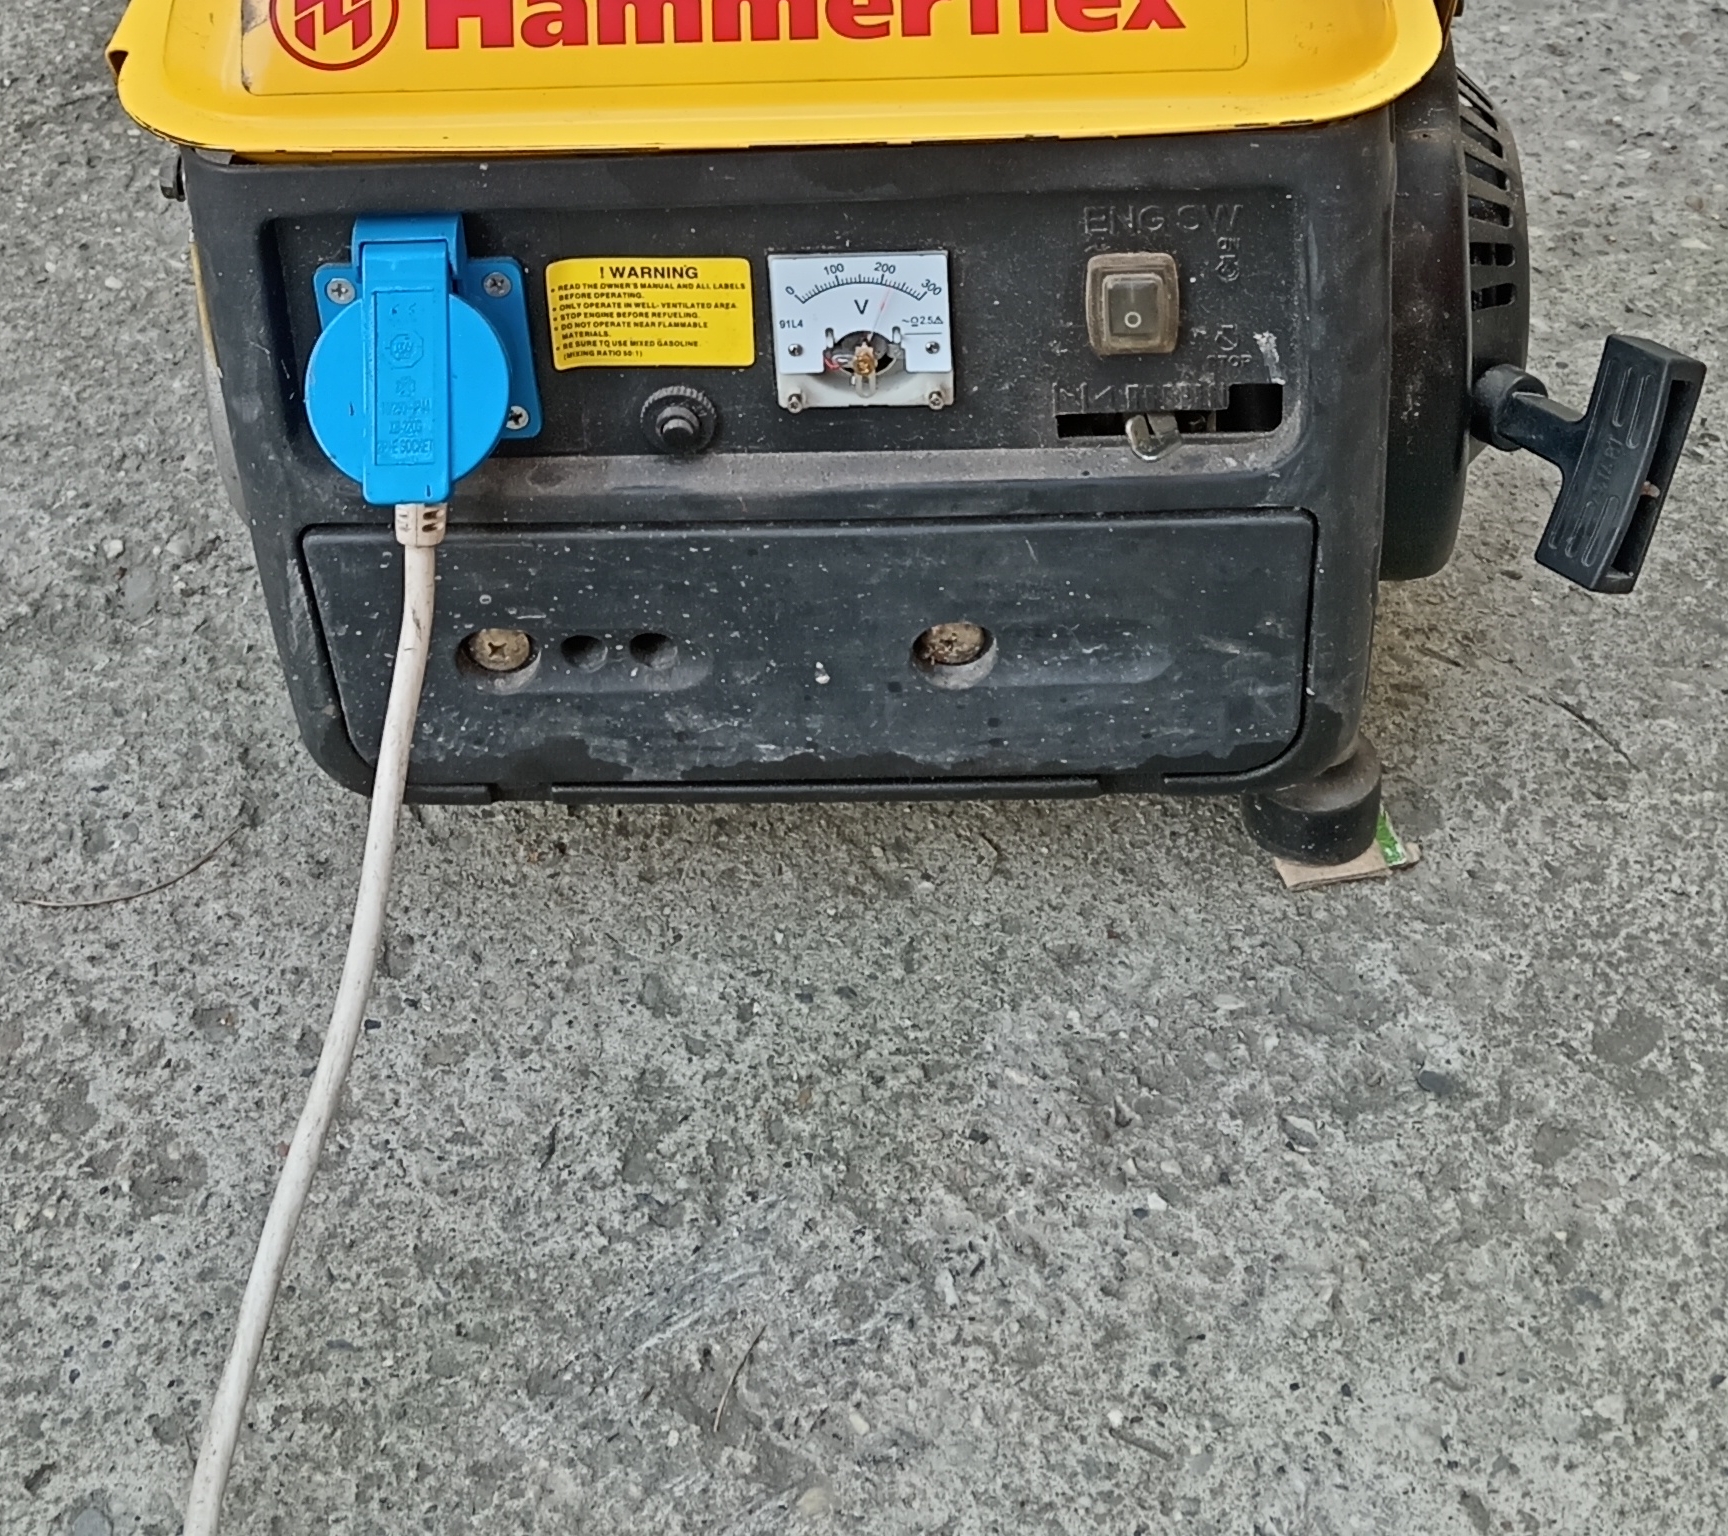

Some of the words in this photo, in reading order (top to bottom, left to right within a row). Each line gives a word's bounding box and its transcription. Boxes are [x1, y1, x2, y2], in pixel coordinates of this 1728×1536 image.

[1083, 204, 1165, 234] ENG
[609, 266, 699, 279] WARNING
[823, 263, 845, 276] 100
[874, 261, 896, 275] 200
[558, 283, 581, 292] READ
[785, 286, 795, 295] 0
[920, 278, 942, 296] 300
[558, 292, 592, 301] BEFORE
[559, 302, 581, 311] ONLY
[854, 299, 869, 315] V
[560, 312, 582, 321] STOP
[561, 322, 573, 330] DO
[779, 319, 804, 329] 91L4
[563, 341, 574, 350] BE
[575, 340, 598, 348] SURE
[563, 350, 595, 360] (MIXING
